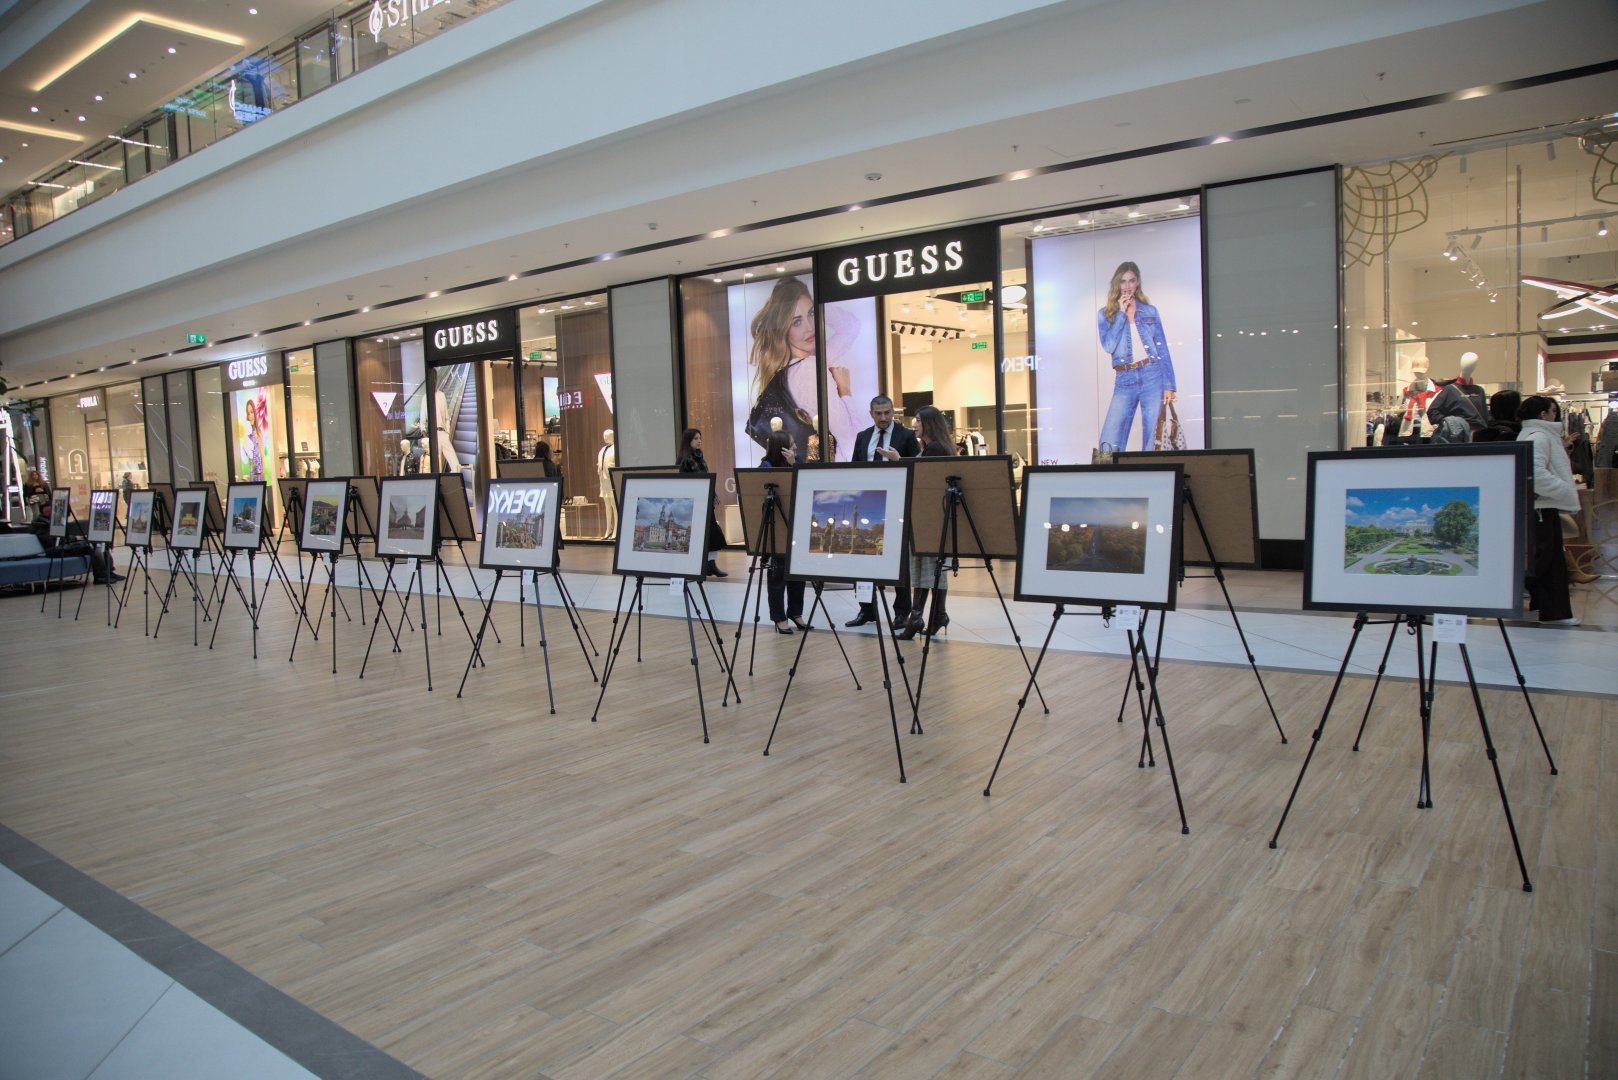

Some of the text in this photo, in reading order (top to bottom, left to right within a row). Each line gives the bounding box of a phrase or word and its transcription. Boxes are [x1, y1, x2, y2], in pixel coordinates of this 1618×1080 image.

[837, 240, 965, 286] GUESS
[434, 319, 499, 350] GUESS
[228, 356, 268, 381] GUESS
